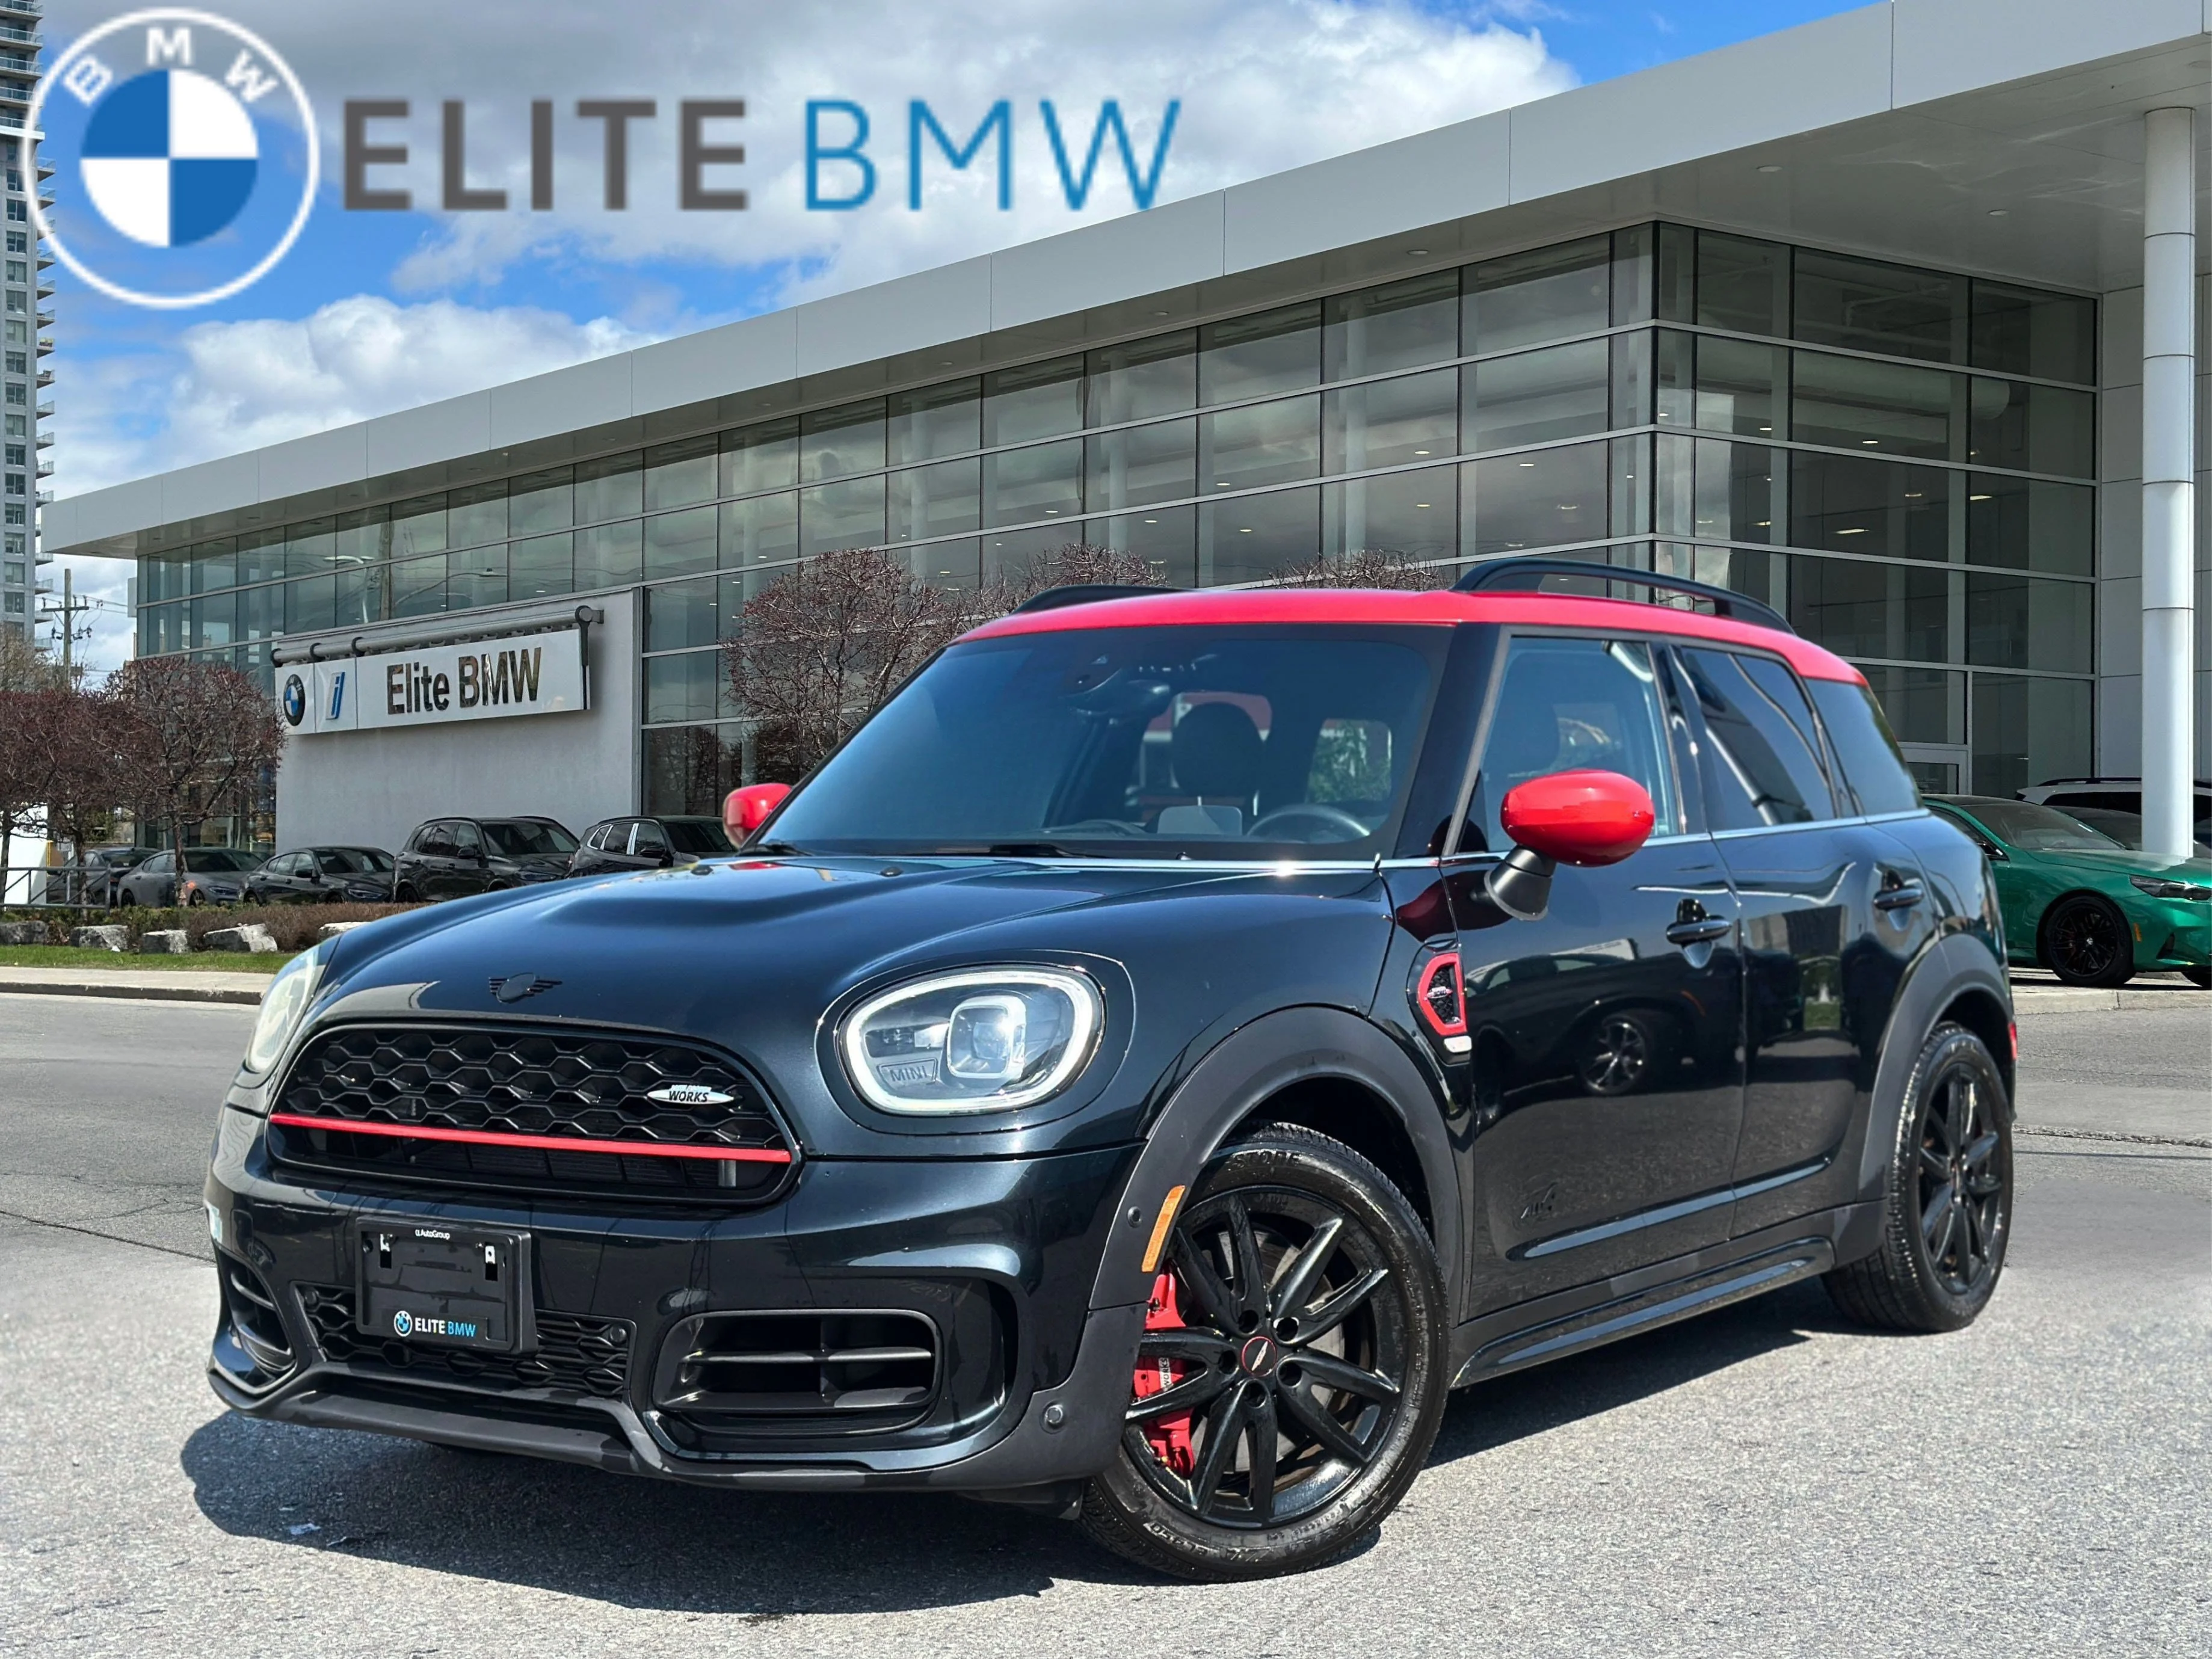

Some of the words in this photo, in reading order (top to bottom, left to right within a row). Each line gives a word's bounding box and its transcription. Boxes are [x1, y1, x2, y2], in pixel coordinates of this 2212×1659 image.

[387, 662, 450, 715] Elite
[458, 647, 541, 708] BMW
[890, 1065, 927, 1082] MINI
[669, 1091, 709, 1103] WORKS
[414, 1317, 445, 1334] ELITE
[448, 1321, 476, 1337] BMW
